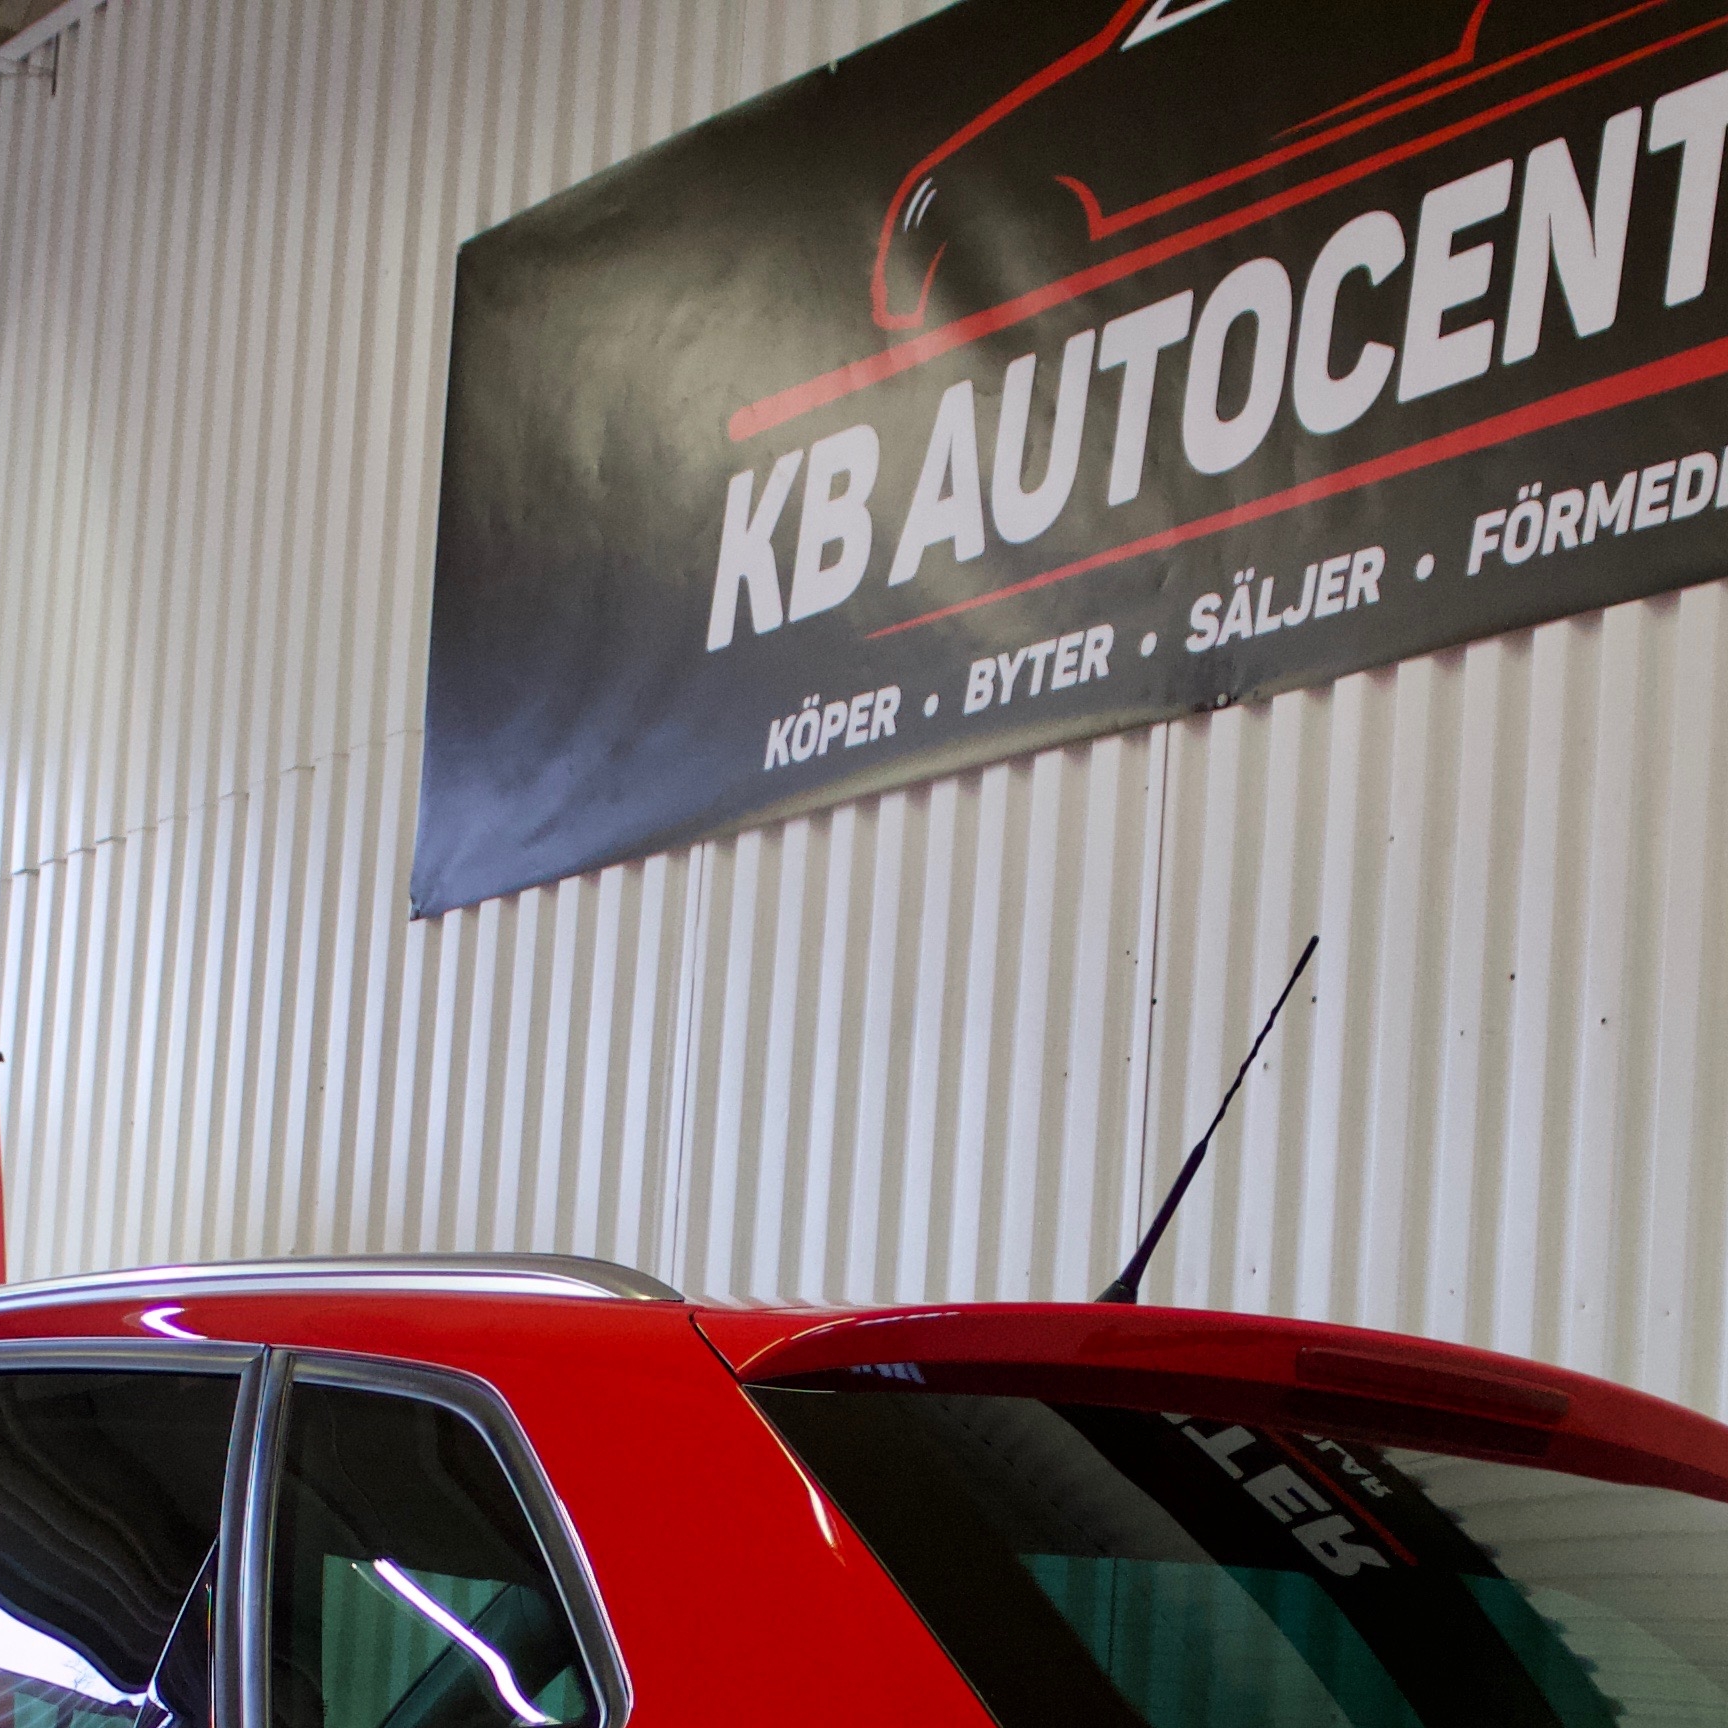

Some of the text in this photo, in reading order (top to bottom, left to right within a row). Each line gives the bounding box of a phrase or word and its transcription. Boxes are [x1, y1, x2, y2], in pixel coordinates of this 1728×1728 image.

[706, 424, 881, 654] KB
[764, 685, 902, 771] KÖPER
[963, 624, 1116, 715] BYTER
[1185, 546, 1387, 653] SÄLJER
